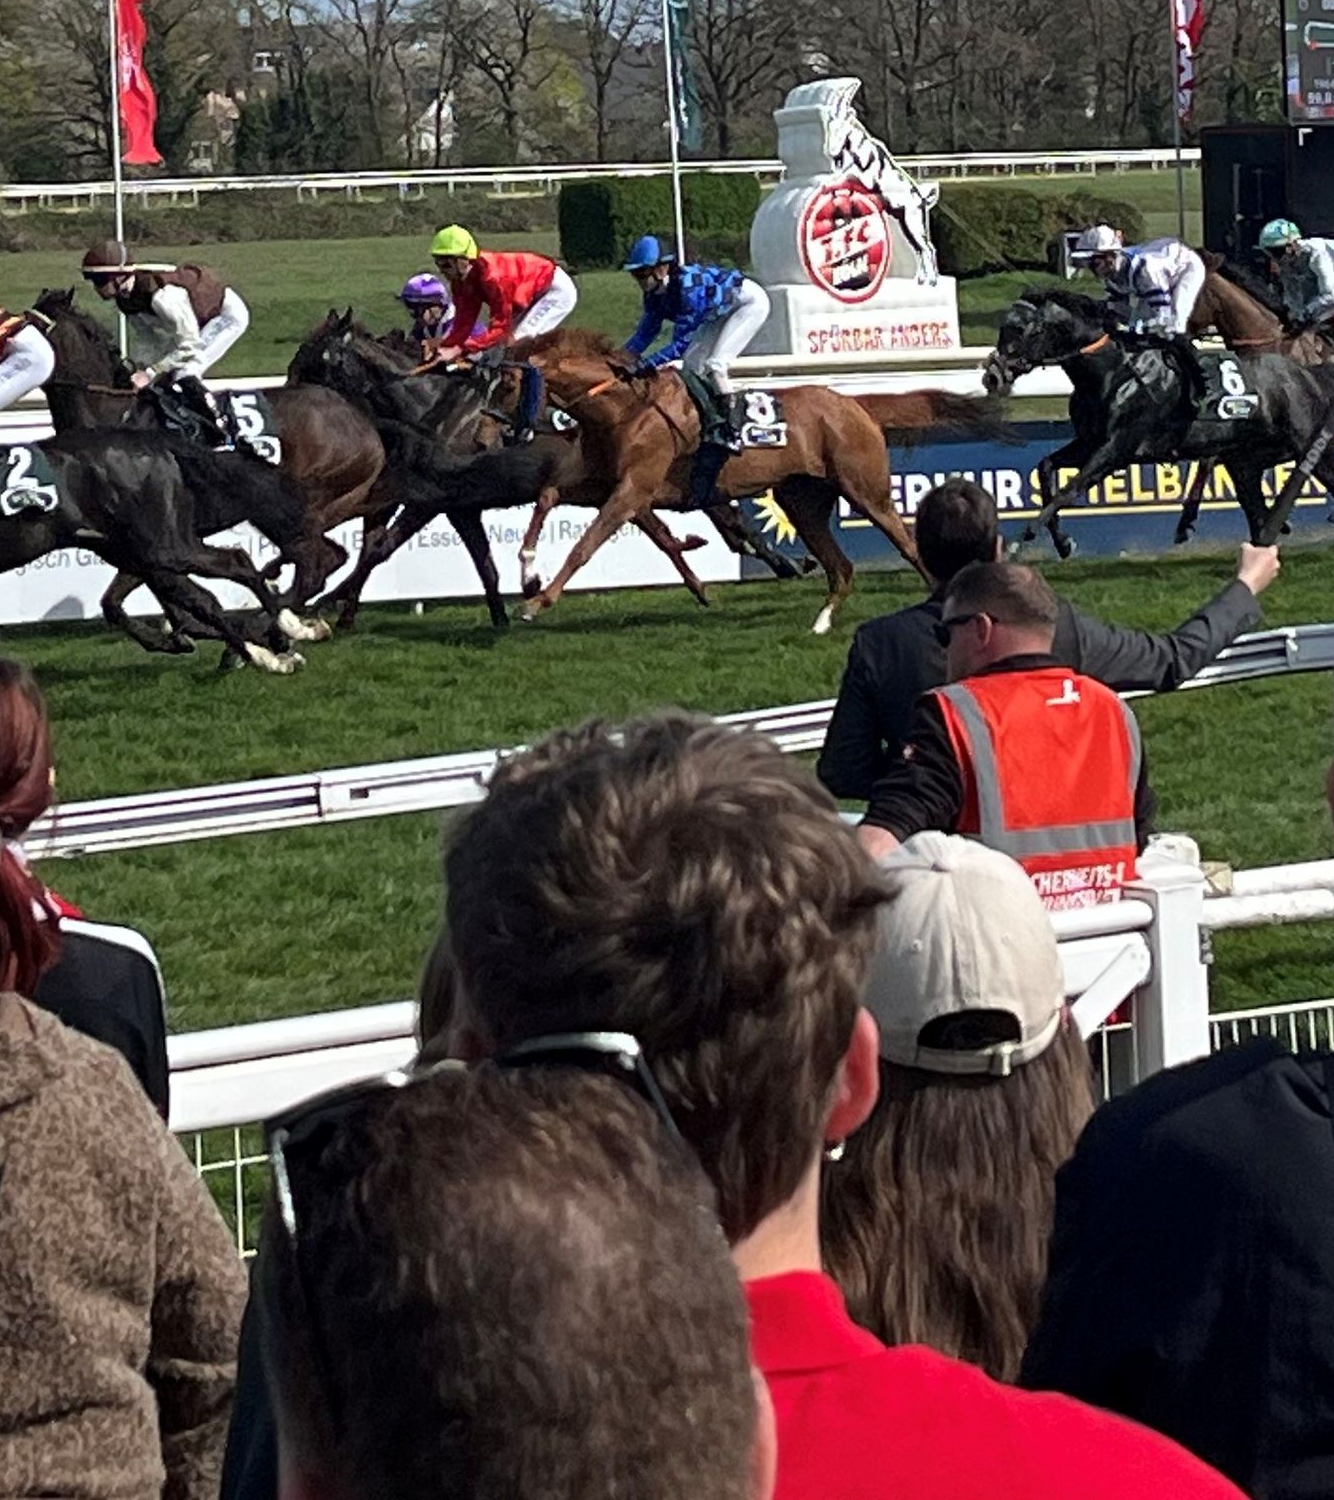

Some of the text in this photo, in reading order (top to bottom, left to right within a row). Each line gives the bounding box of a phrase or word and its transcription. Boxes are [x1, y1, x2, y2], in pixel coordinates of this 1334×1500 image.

[1219, 359, 1246, 397] 6
[229, 393, 265, 438] 5
[6, 445, 39, 488] 2
[417, 528, 463, 549] Esse
